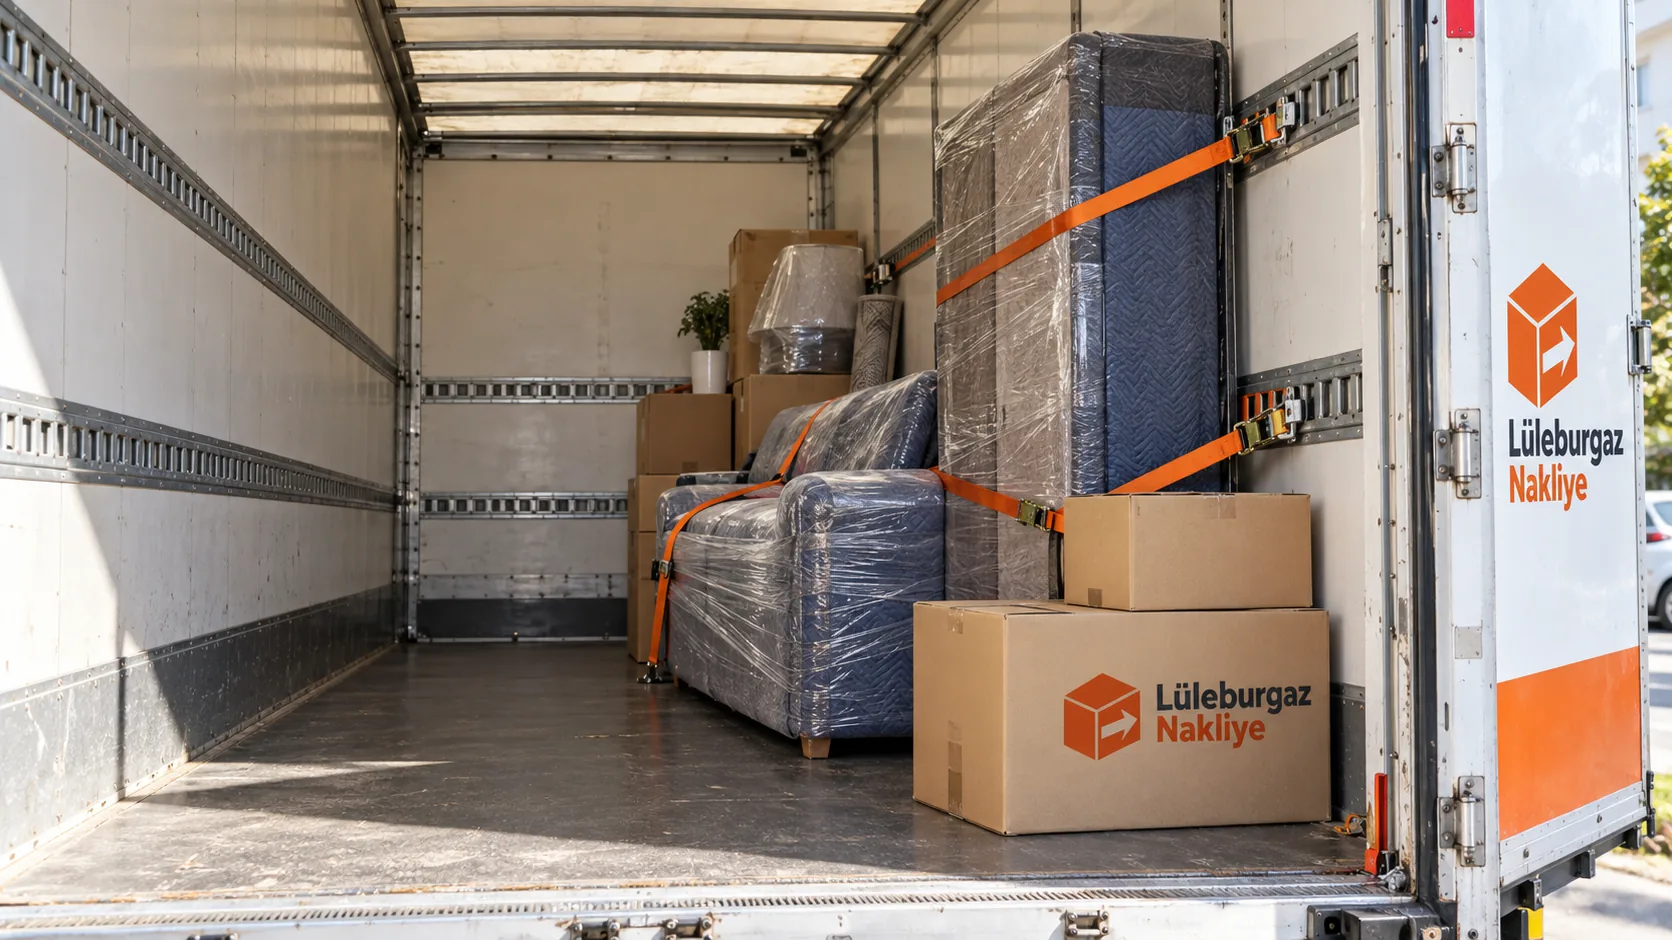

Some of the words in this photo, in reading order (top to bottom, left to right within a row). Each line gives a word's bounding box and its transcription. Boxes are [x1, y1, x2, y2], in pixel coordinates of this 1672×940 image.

[1508, 418, 1624, 467] Lüleburgaz
[1509, 462, 1588, 512] Nakliye
[1156, 680, 1312, 714] Lüleburgaz
[1156, 712, 1266, 749] Nakliye
